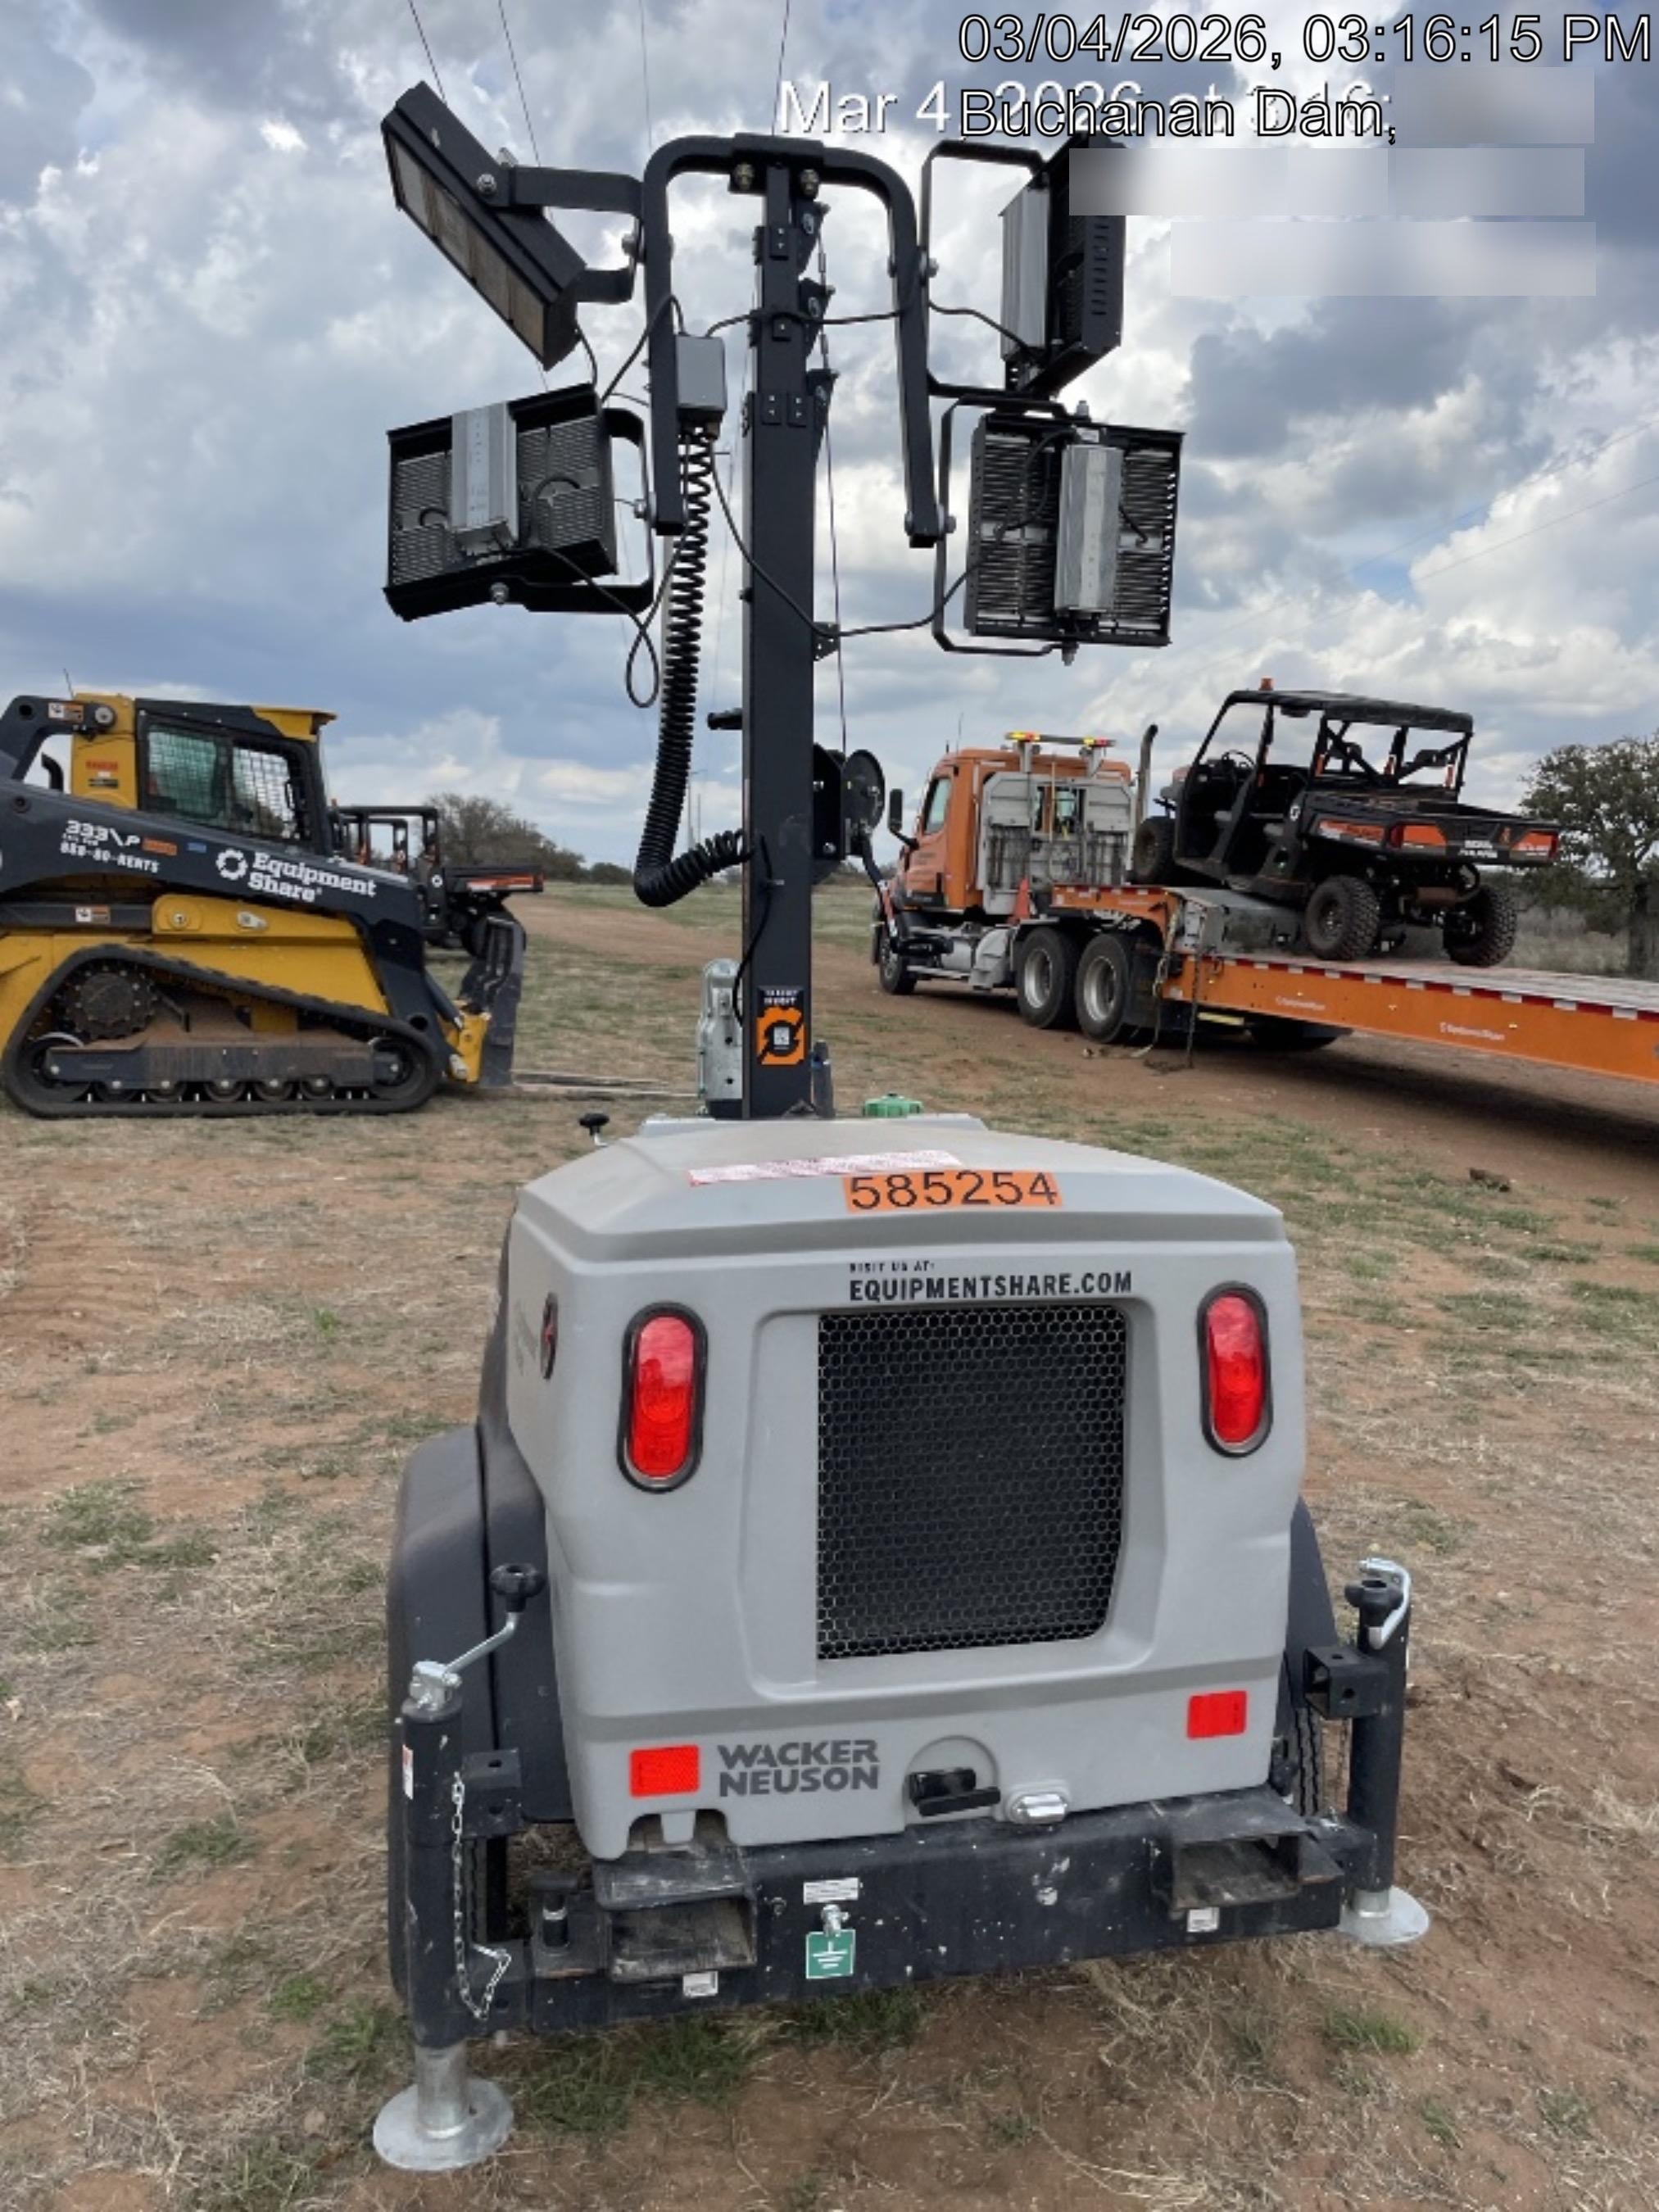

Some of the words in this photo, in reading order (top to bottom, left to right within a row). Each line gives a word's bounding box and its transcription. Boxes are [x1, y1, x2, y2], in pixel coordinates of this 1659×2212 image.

[252, 851, 377, 898] Equipment
[850, 1170, 1058, 1210] 585254
[849, 1271, 1132, 1303] EQUIPMENTSHARE.COM
[717, 1739, 881, 1770] WACKER
[719, 1765, 881, 1797] NEUSON
